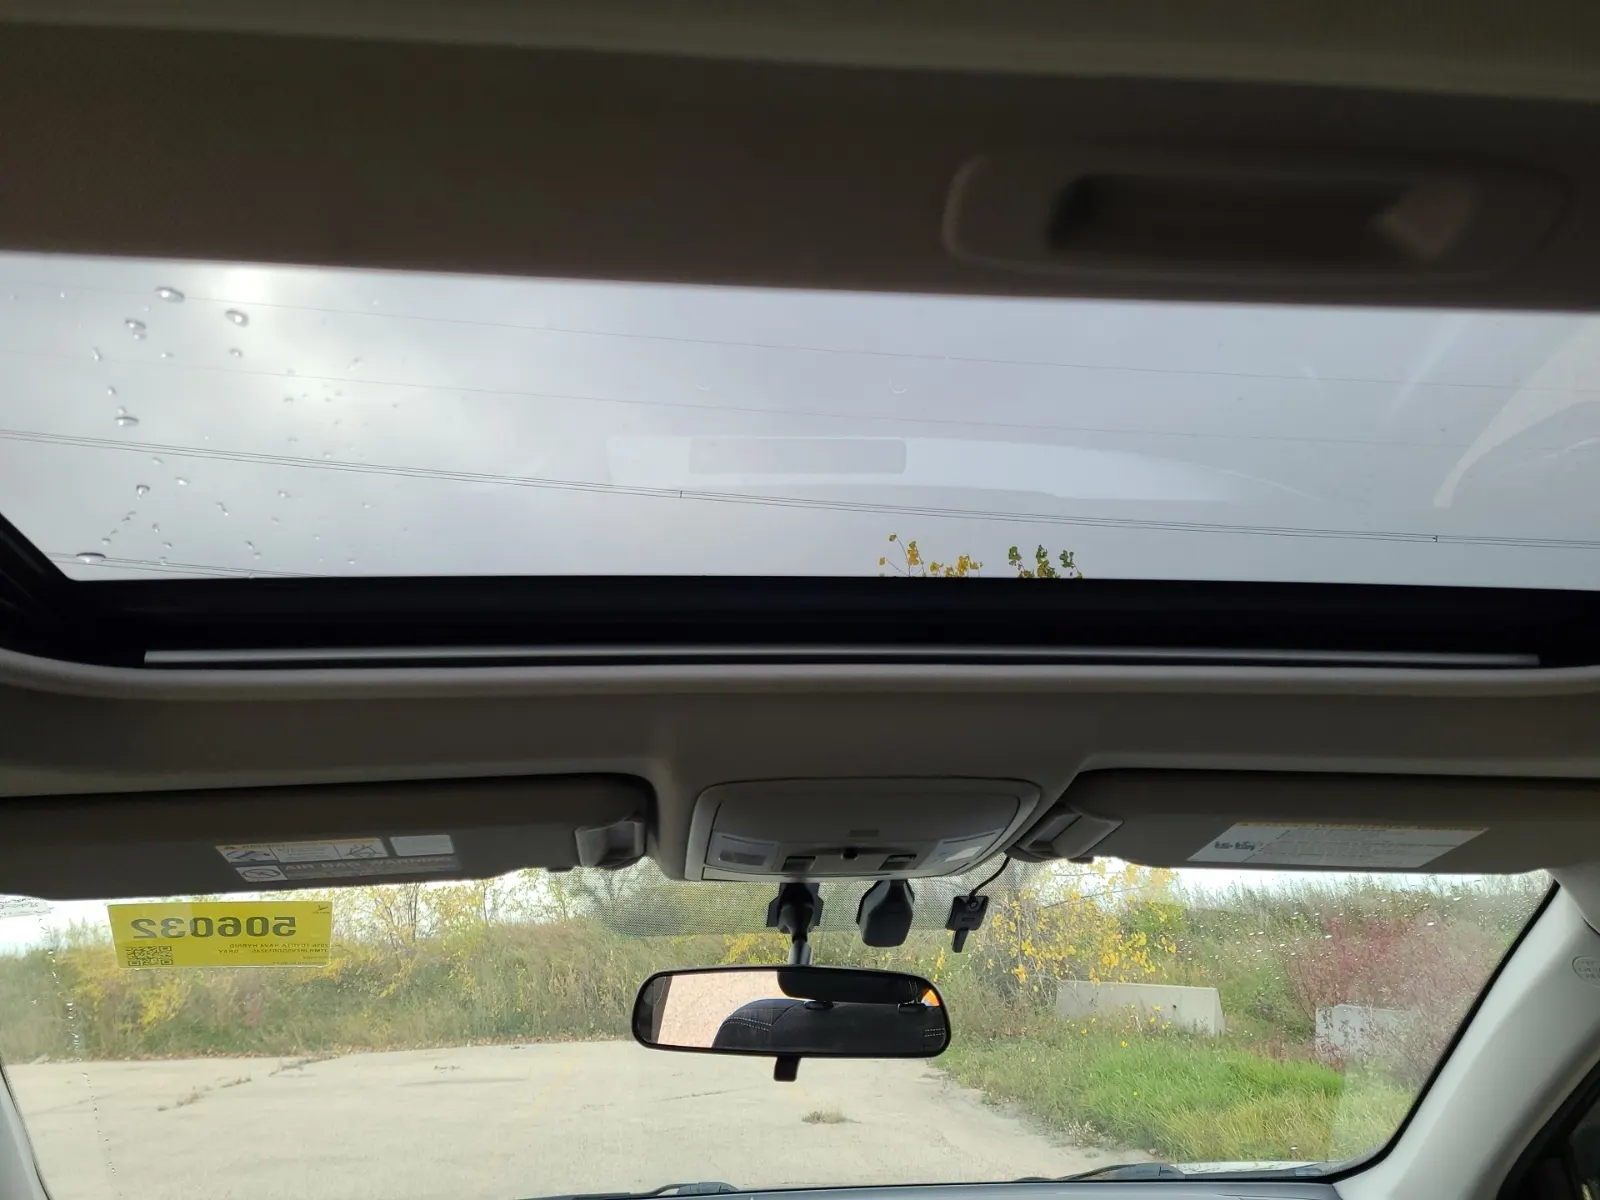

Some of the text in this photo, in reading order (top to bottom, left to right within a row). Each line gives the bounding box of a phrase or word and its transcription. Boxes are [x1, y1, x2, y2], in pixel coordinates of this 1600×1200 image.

[285, 855, 452, 871] AIR BAG WARNING
